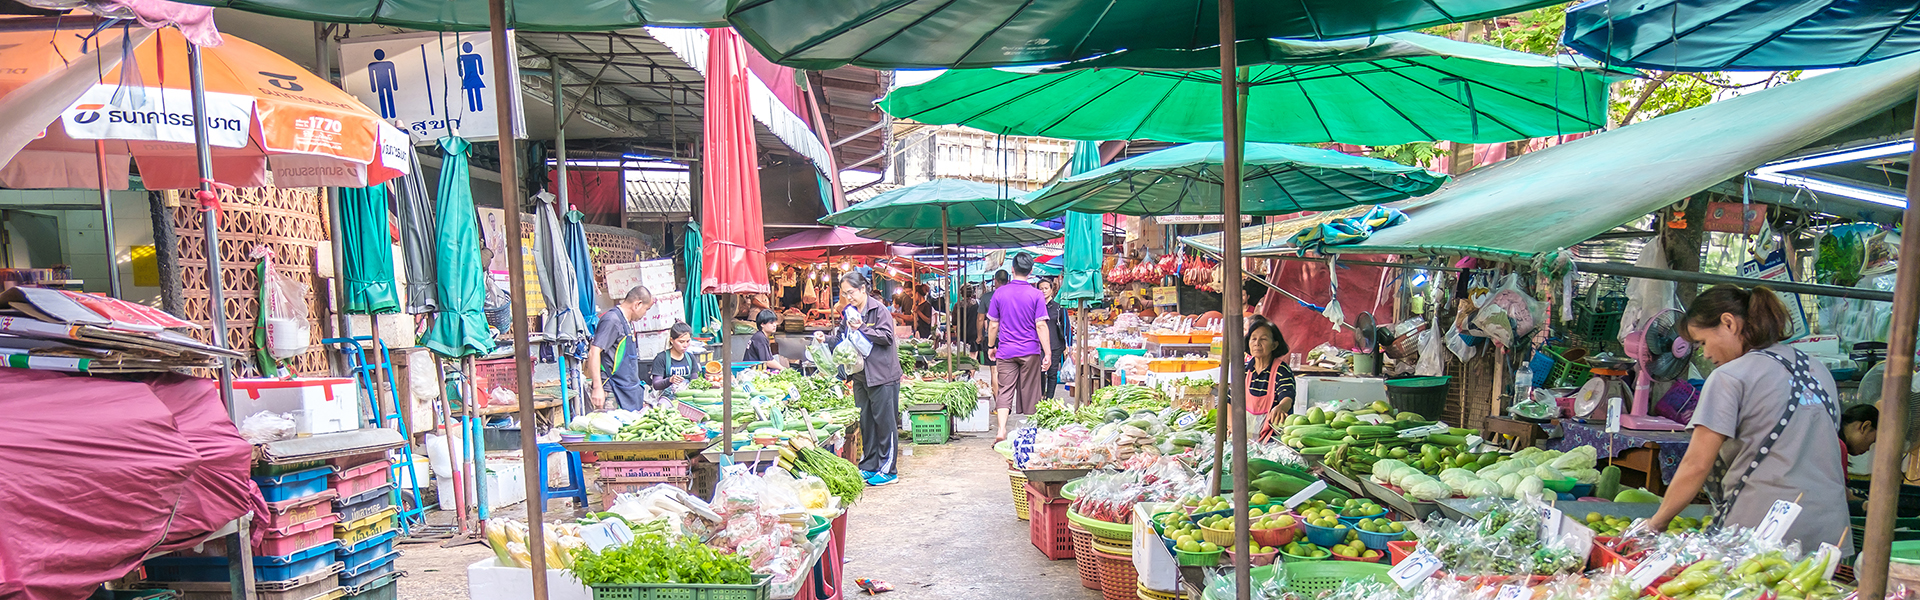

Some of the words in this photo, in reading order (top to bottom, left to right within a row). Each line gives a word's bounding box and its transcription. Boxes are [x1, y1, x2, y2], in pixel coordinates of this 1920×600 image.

[108, 110, 241, 132] ธนาคารธชาต
[309, 116, 342, 133] 1770
[1395, 557, 1423, 580] 10
